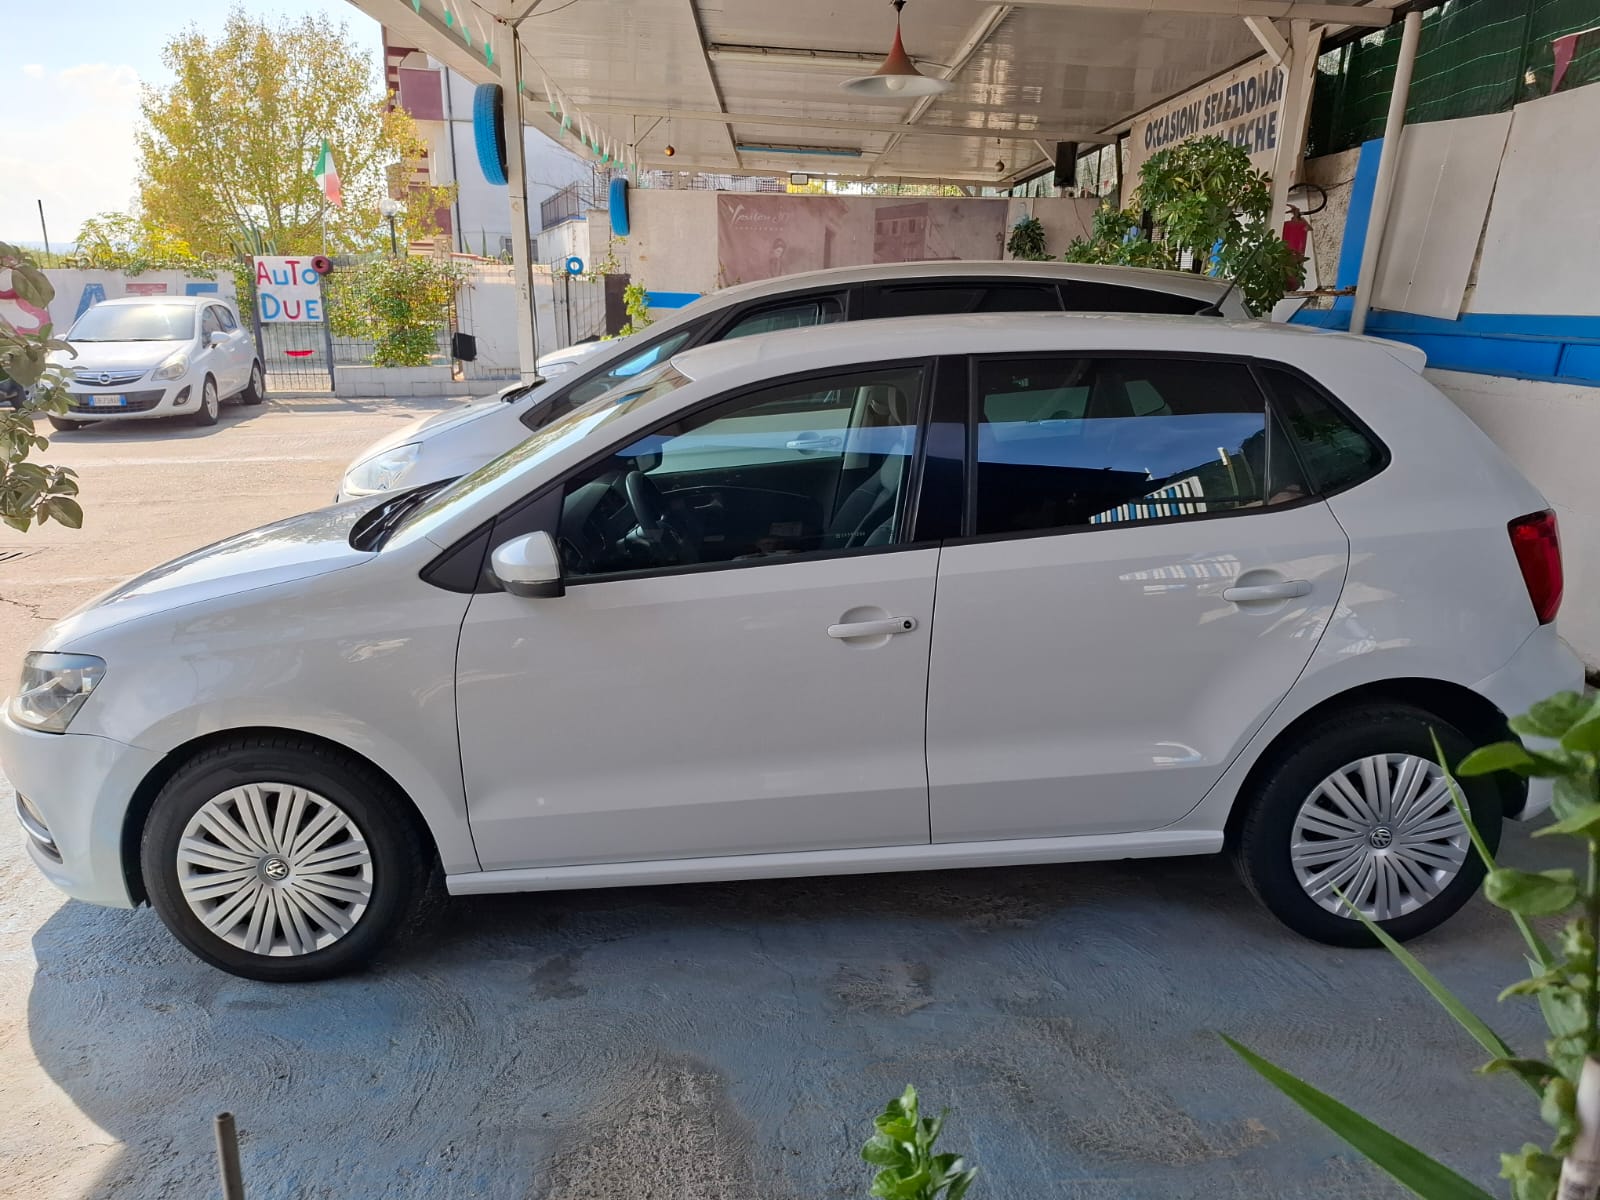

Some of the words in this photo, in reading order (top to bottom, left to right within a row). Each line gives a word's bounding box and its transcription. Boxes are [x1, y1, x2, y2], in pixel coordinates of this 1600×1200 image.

[1144, 100, 1202, 150] OCCASIONI
[1216, 111, 1278, 155] ARCHE
[260, 292, 320, 320] DUE
